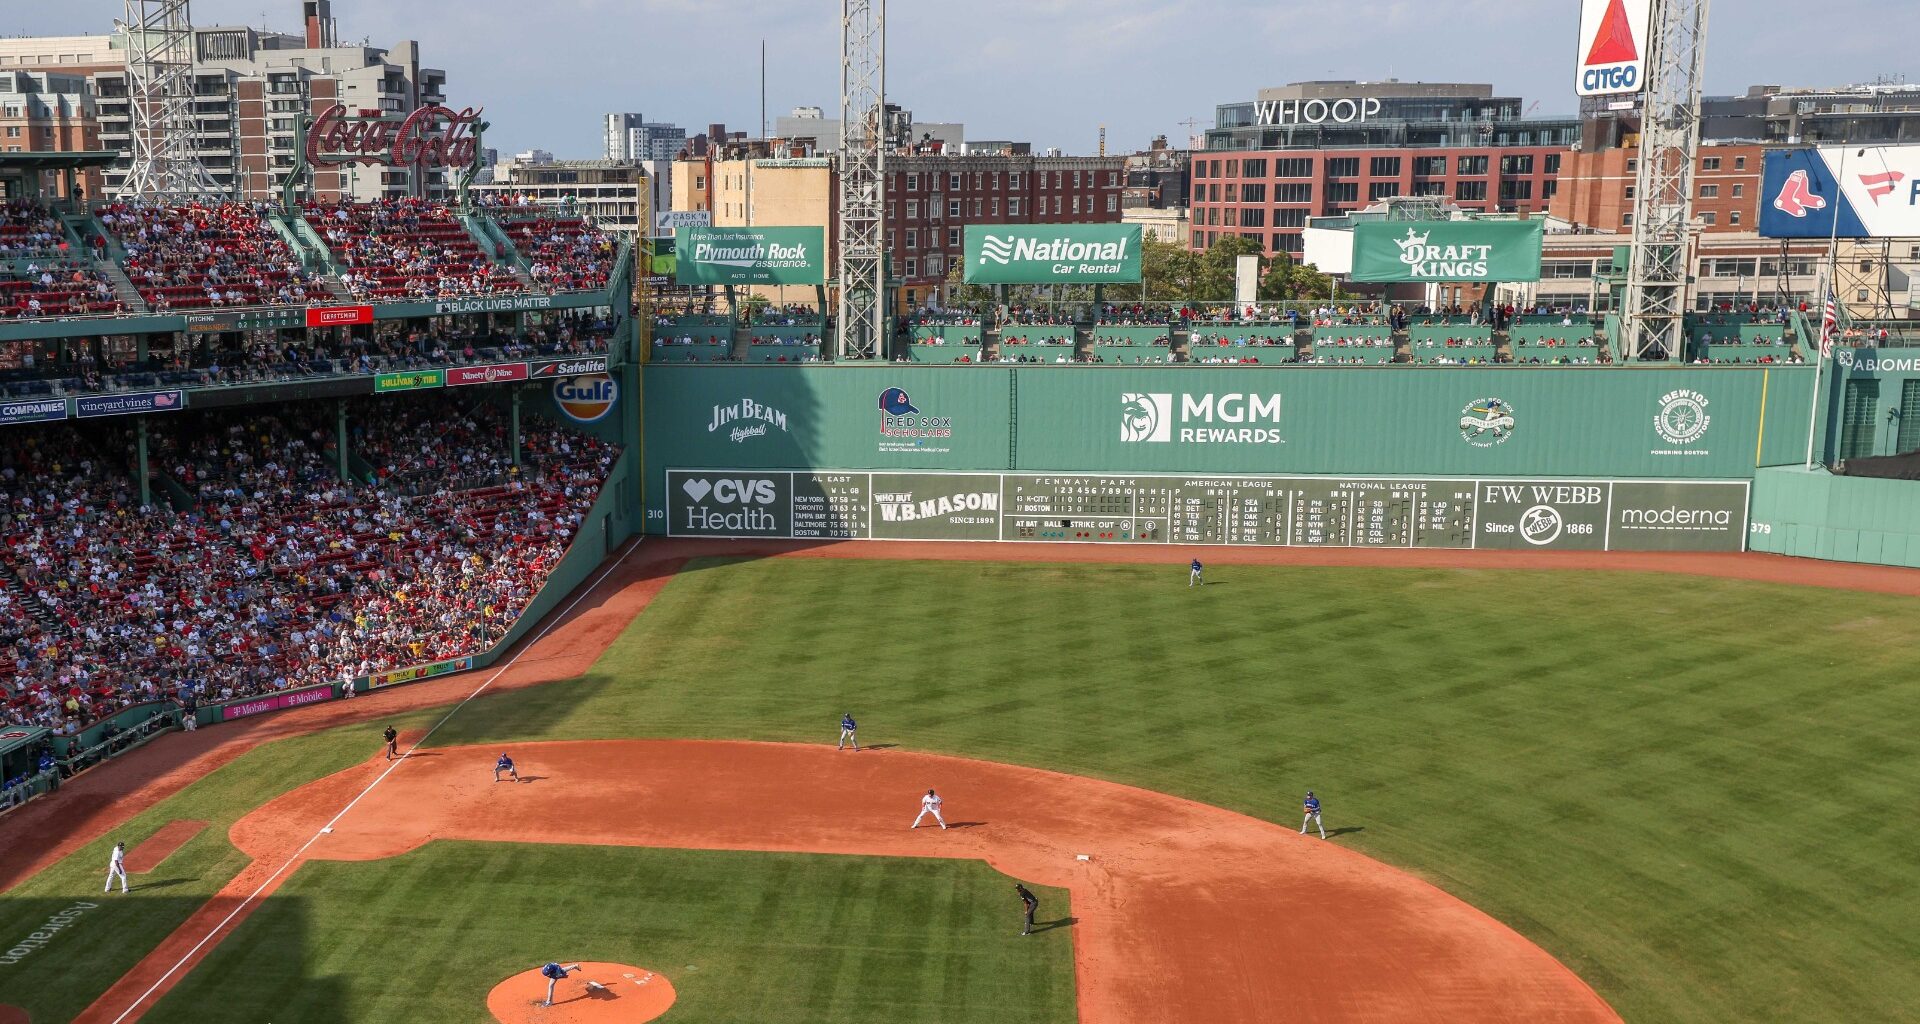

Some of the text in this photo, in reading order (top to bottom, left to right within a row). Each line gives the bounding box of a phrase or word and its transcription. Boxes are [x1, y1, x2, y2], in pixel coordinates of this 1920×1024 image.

[1583, 66, 1636, 90] CITGO
[1254, 98, 1380, 124] WHOOP
[695, 243, 764, 262] Plymouth
[768, 243, 806, 259] Rock
[1400, 244, 1492, 265] DRAFT
[1052, 263, 1121, 274] Car Rental
[1410, 262, 1488, 277] KINGS
[452, 297, 550, 312] BLACK LIVES MATTER
[323, 312, 356, 320] CRAFTSMAN
[462, 370, 484, 380] Ninety
[497, 368, 512, 377] Nine
[558, 361, 605, 374] Safelite
[382, 376, 437, 387] SULLIVAN TIRE
[557, 380, 612, 400] Gulf
[81, 398, 124, 414] vineyard
[126, 397, 152, 408] vines
[1658, 389, 1709, 407] IBEW 103
[3, 403, 64, 415] COMPANIES
[709, 398, 787, 432] JIM BEAM
[1182, 394, 1281, 423] MGM
[1503, 402, 1514, 413] SOX
[886, 417, 950, 427] RED SOX
[1654, 415, 1664, 436] NECA
[1662, 416, 1710, 444] CONTRACTORS
[885, 428, 950, 437] SCHOLARS
[1180, 428, 1280, 443] REWARDS
[1497, 430, 1511, 445] FUND
[714, 479, 776, 504] CVS
[875, 493, 912, 502] WHO BUT
[1532, 486, 1602, 504] WEBB
[647, 510, 663, 519] 310
[686, 506, 776, 530] Health
[1621, 506, 1730, 524] moderna
[1486, 523, 1515, 534] Since
[1530, 516, 1554, 533] WEBB
[1566, 523, 1592, 534] 1866
[1751, 522, 1770, 534] 379
[296, 691, 323, 704] Mobile
[242, 702, 269, 714] Mobile
